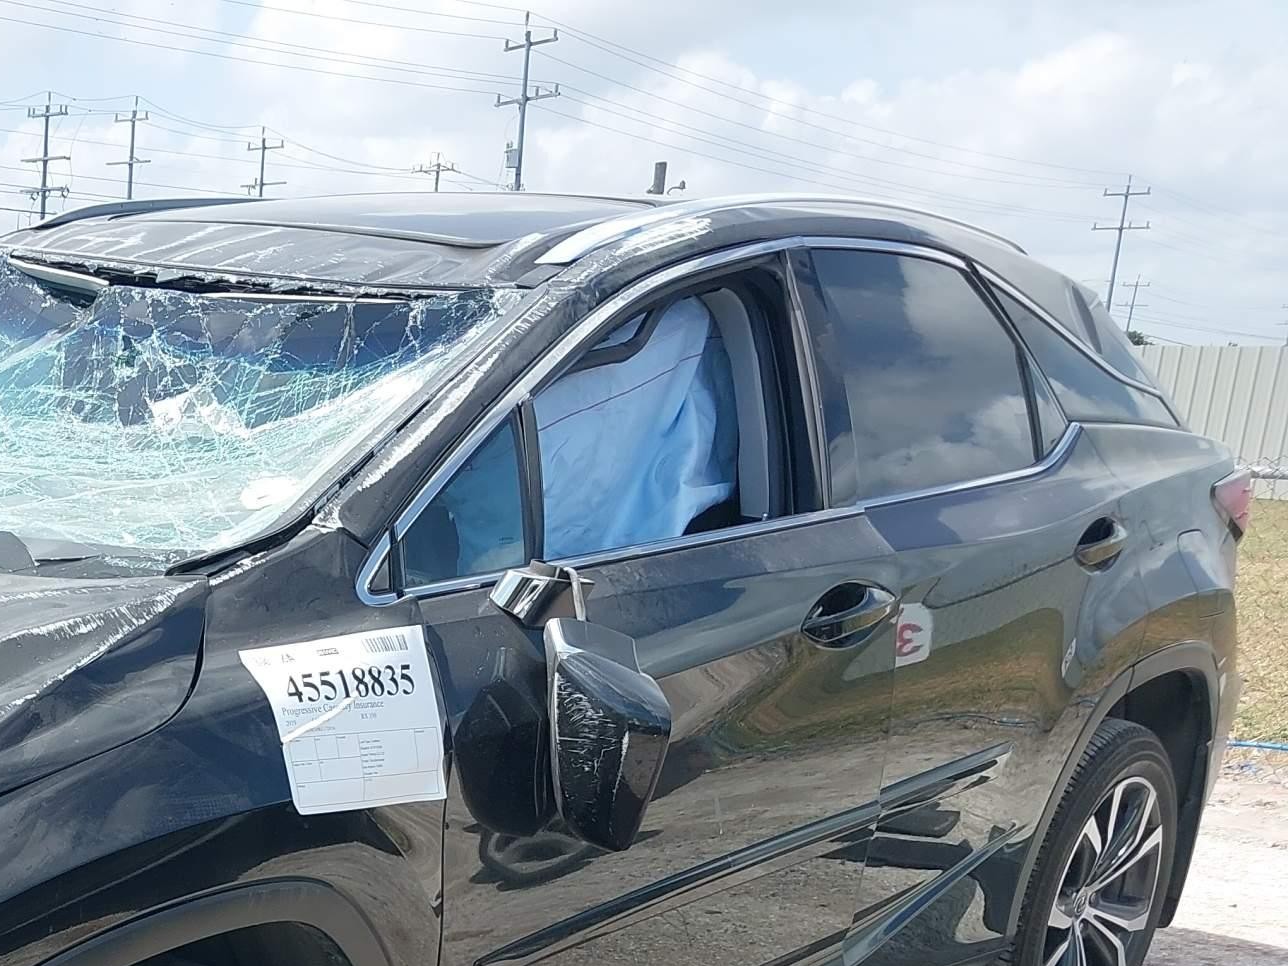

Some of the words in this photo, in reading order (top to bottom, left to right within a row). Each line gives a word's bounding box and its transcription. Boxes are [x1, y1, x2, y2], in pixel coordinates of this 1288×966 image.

[287, 664, 415, 703] 45518835
[281, 706, 322, 717] Progressive
[353, 700, 384, 710] Insurance
